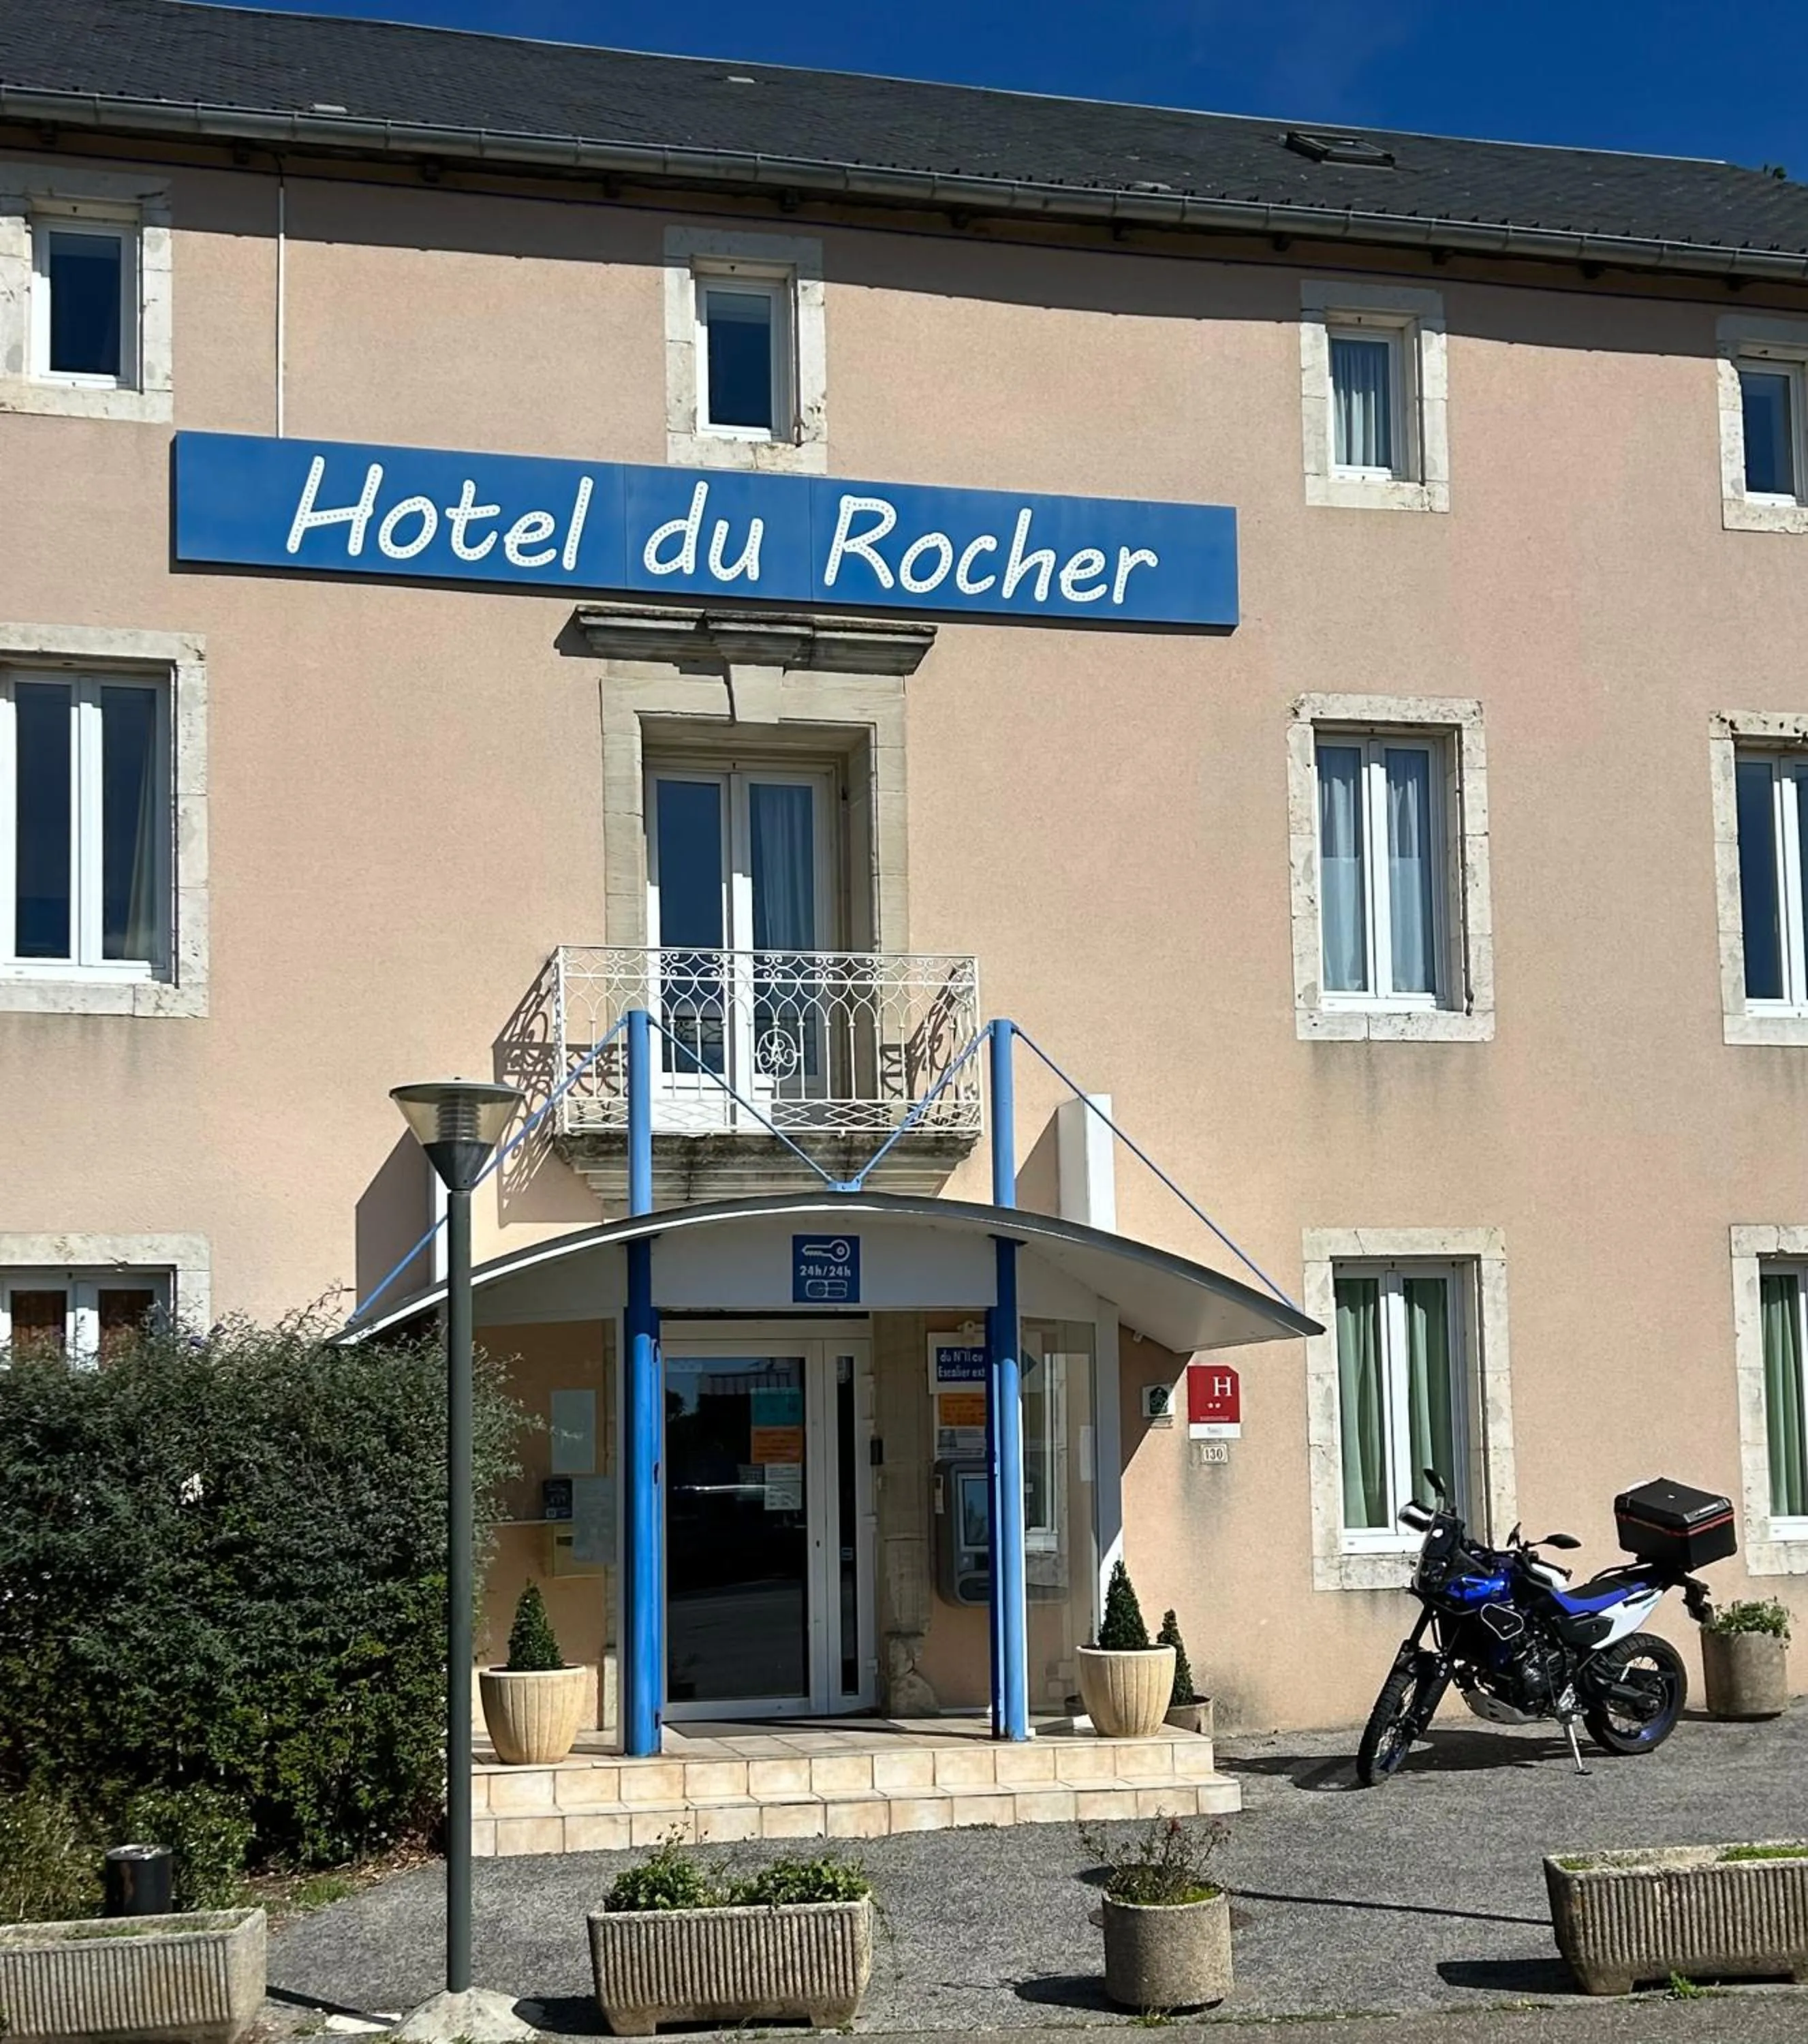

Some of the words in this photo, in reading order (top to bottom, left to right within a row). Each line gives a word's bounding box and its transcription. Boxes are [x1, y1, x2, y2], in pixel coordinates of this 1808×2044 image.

[285, 454, 594, 571] Hotel
[643, 480, 764, 582] du
[824, 495, 1159, 604] Rocher
[799, 1265, 851, 1276] 24h/24h
[937, 1365, 970, 1378] Escalier
[1213, 1376, 1232, 1397] H
[1205, 1447, 1223, 1460] 130
